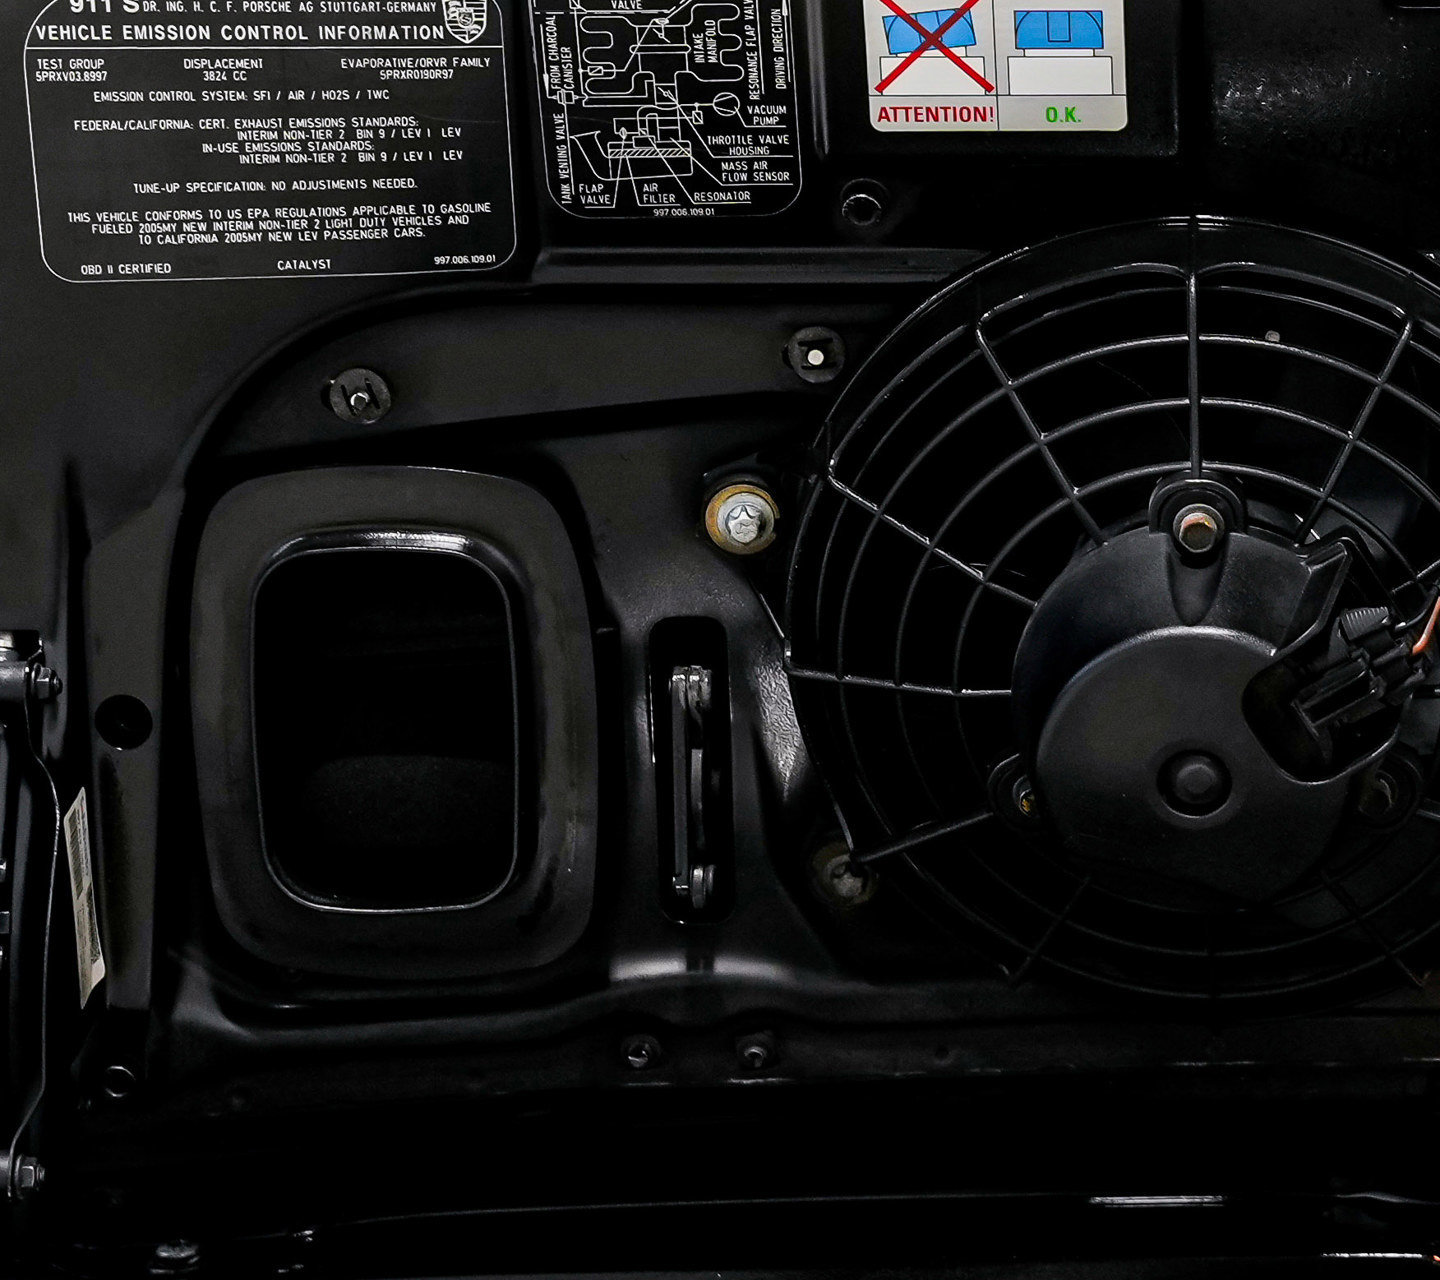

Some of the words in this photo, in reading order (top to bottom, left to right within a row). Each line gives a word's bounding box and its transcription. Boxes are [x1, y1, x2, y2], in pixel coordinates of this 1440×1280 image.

[143, 1, 160, 12] DR.
[166, 1, 187, 12] ING.
[194, 1, 203, 12] H.
[210, 1, 220, 12] C.
[227, 1, 236, 12] F.
[243, 1, 291, 12] PORSCHE
[299, 1, 313, 12] AG
[320, 1, 436, 12] STUTTGART-GERMANY
[611, 0, 642, 9] VALVE
[36, 25, 112, 40] VEHICLE
[123, 25, 210, 40] EMISSION
[221, 25, 308, 40] CONTROL
[319, 25, 444, 40] INFORMATION
[546, 16, 559, 55] CHARCOAL
[771, 9, 783, 52] DIRECTION
[705, 20, 718, 62] MANIFOLD
[746, 27, 756, 46] FLAP
[693, 33, 704, 62] INTAKE
[37, 59, 62, 69] TEST
[70, 59, 104, 69] GROUP
[184, 59, 262, 69] DISPLACEMENT
[341, 58, 447, 68] EVAPORATIVE/ORVR
[453, 58, 490, 67] FAMILY
[564, 47, 574, 89] CANISTER
[203, 71, 227, 81] 3824
[233, 71, 246, 80] CC
[550, 60, 561, 89] FROM
[750, 52, 759, 99] RESONANCE
[774, 57, 786, 89] DRIVING
[747, 105, 786, 114] VACUUM
[878, 106, 993, 122] ATTENTION!
[1046, 107, 1081, 122] O.K.
[74, 120, 193, 131] FEDERAL/CALIFORNIA:
[199, 119, 229, 129] CERT.
[235, 118, 282, 129] EXHAUST
[289, 118, 345, 128] EMISSIONS
[352, 116, 418, 127] STANDARDS:
[553, 113, 565, 134] VALVE
[754, 116, 779, 127] PUMP
[708, 135, 753, 144] THROTTLE
[759, 135, 789, 144] VALVE
[202, 143, 238, 153] IN-USE
[245, 142, 301, 152] EMISSIONS
[308, 141, 375, 151] STANDARDS:
[730, 146, 769, 155] HOUSING
[557, 140, 569, 173] VENTING
[722, 161, 747, 170] MASS
[754, 161, 767, 169] AIR
[723, 173, 747, 182] FLOW
[754, 172, 789, 181] SENSOR
[134, 183, 180, 193] TUNE-UP
[186, 182, 265, 192] SPECIFICATION:
[272, 181, 285, 190] NO
[292, 179, 367, 190] ADJUSTMENTS
[373, 178, 417, 188] NEEDED.
[561, 179, 574, 203] TANK
[579, 184, 603, 193] FLAP
[643, 183, 658, 191] AIR
[580, 195, 610, 204] VALVE
[644, 194, 675, 203] FILTER
[694, 191, 750, 201] RESONATOR
[68, 213, 90, 222] THIS
[96, 212, 139, 222] VEHICLE
[145, 210, 202, 221] CONFORMS
[209, 209, 221, 219] TO
[228, 209, 242, 219] US
[248, 209, 269, 218] EPA
[275, 207, 346, 218] REGULATIONS
[353, 205, 416, 215] APPLICABLE
[423, 204, 434, 214] TO
[441, 203, 491, 213] GASOLINE
[139, 235, 151, 244] TO
[157, 234, 218, 244] CALIFORNIA
[225, 232, 262, 243] 2005MY
[269, 232, 292, 241] NEW
[299, 231, 317, 241] LEV
[324, 229, 388, 240] PASSENGER
[394, 227, 425, 237] CARS.
[278, 259, 330, 270] CATALYST
[434, 255, 495, 264] 997.006.109.01
[81, 265, 102, 274] OBD
[108, 265, 113, 273] II
[119, 264, 171, 274] CERTIFIED
